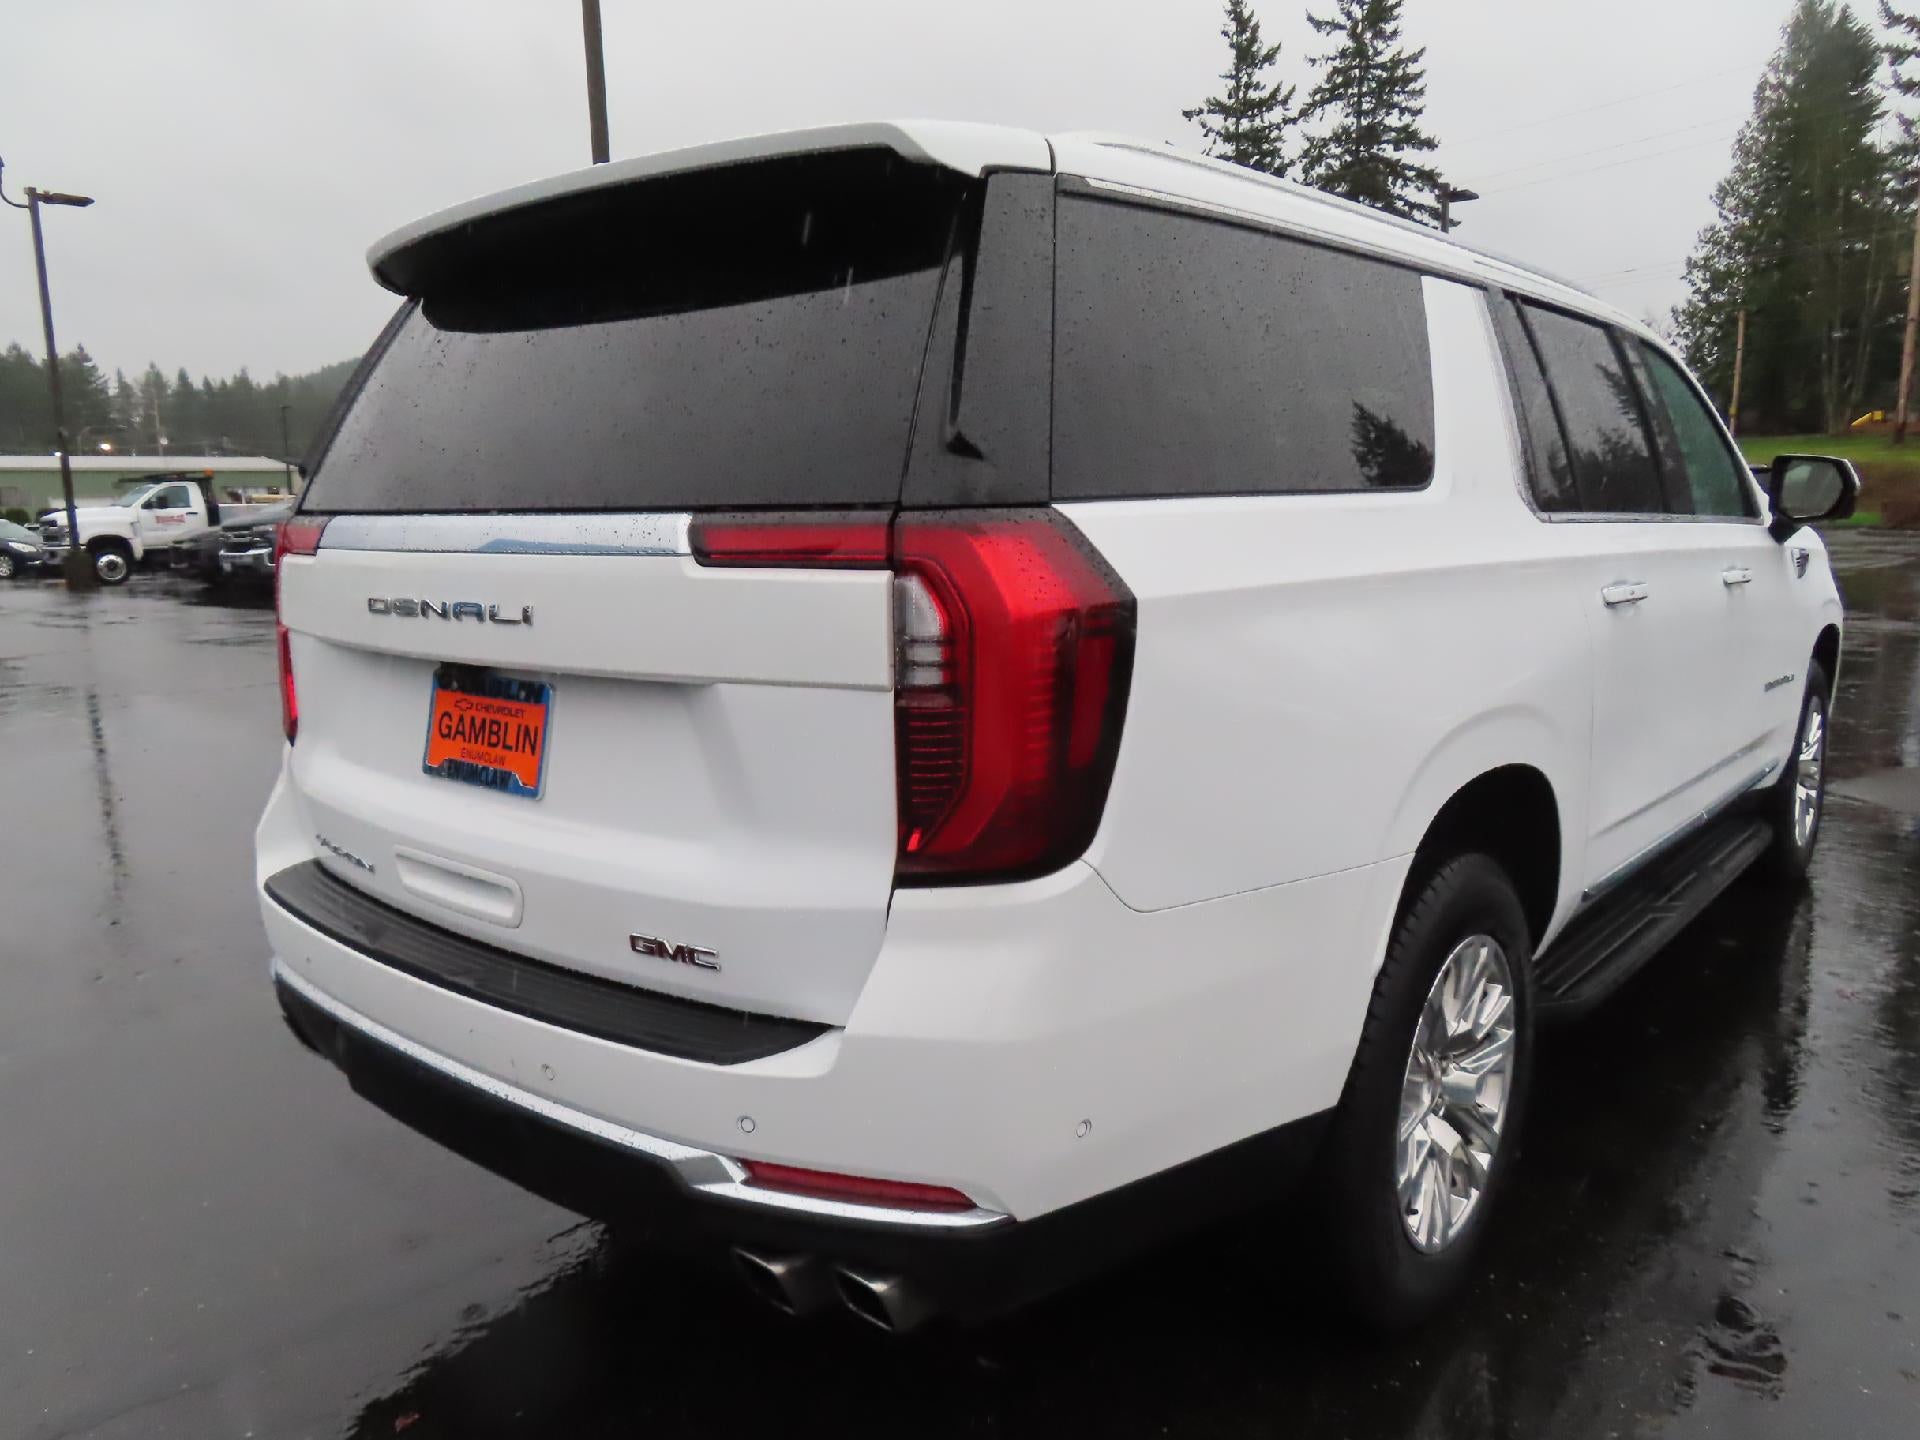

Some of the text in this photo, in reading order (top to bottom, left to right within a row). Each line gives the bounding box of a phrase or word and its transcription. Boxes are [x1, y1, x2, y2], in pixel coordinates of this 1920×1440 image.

[368, 597, 534, 627] DENALI
[438, 710, 539, 756] GAMBLIN
[629, 932, 721, 971] GMC
